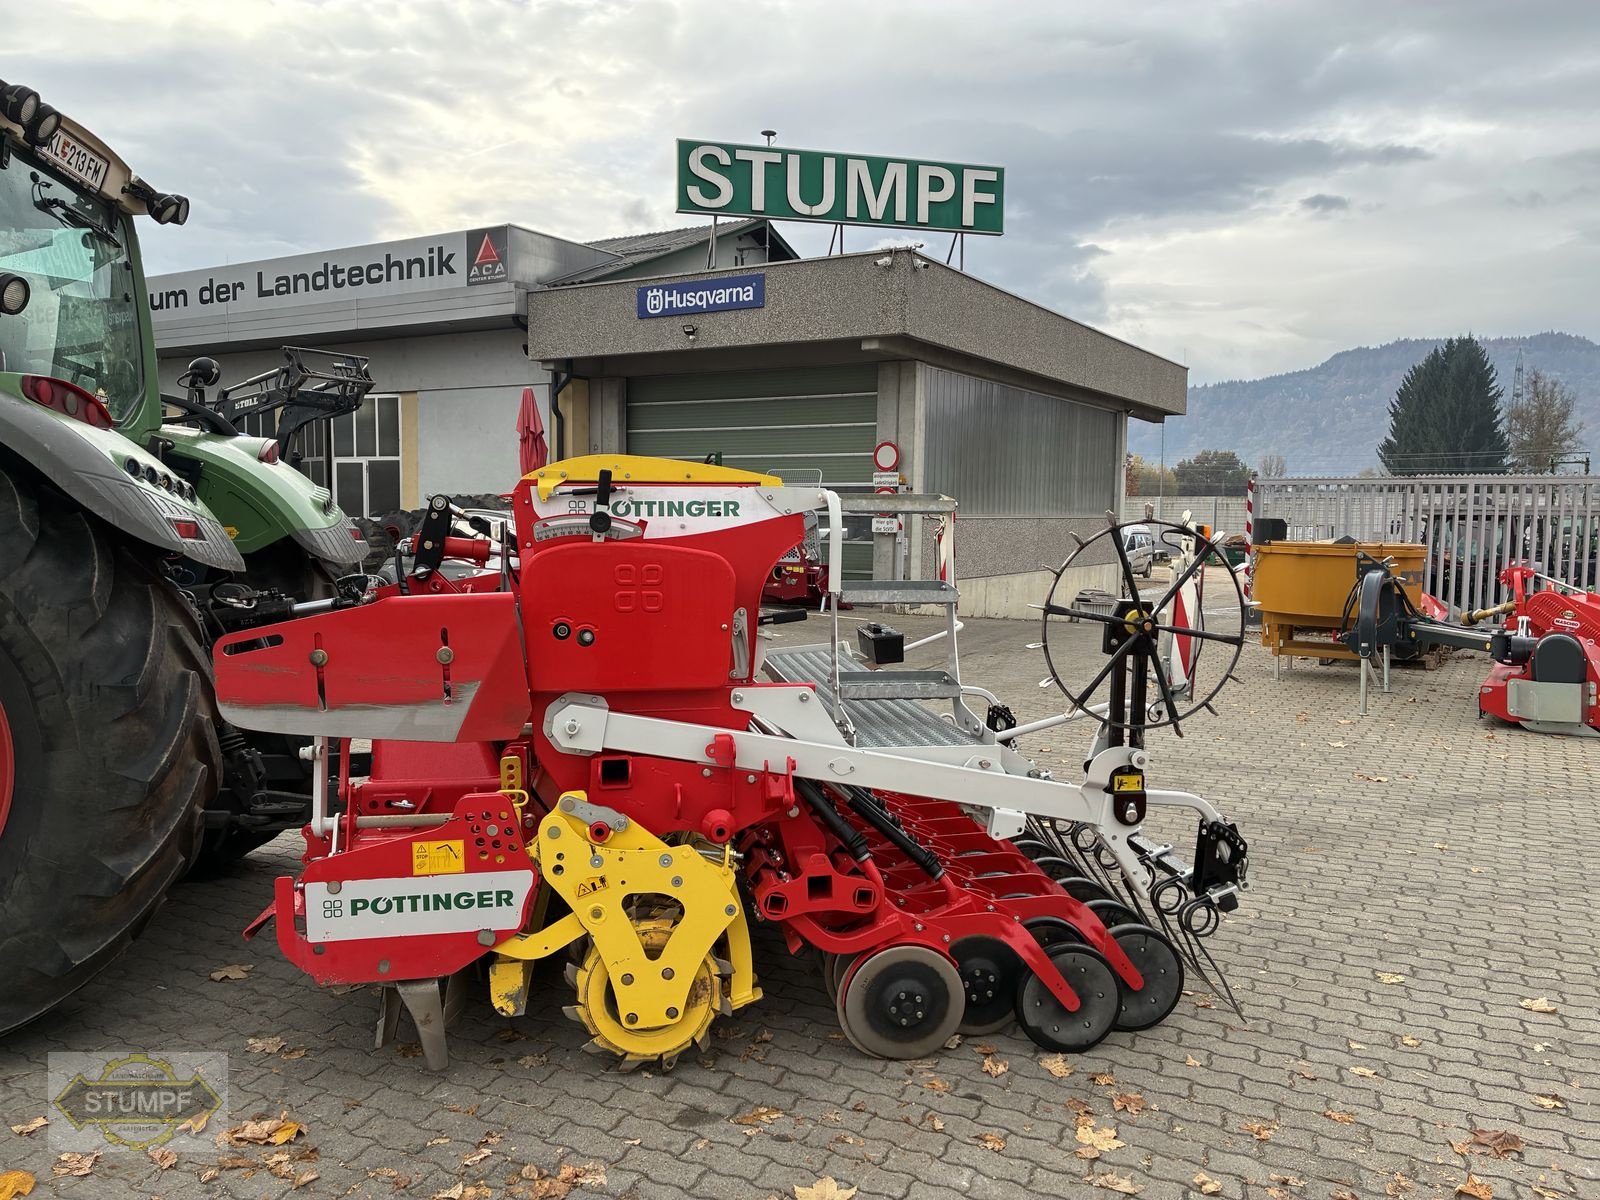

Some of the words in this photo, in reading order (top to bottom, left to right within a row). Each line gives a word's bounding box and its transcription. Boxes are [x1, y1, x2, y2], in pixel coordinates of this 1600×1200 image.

[686, 145, 998, 227] STUMPF
[150, 289, 188, 310] um
[199, 278, 245, 305] der
[257, 246, 457, 298] Landtechnik
[470, 262, 505, 277] ACA
[664, 286, 754, 309] Husqvarna
[235, 397, 258, 409] STOLL
[350, 890, 514, 916] PÖTTINGER
